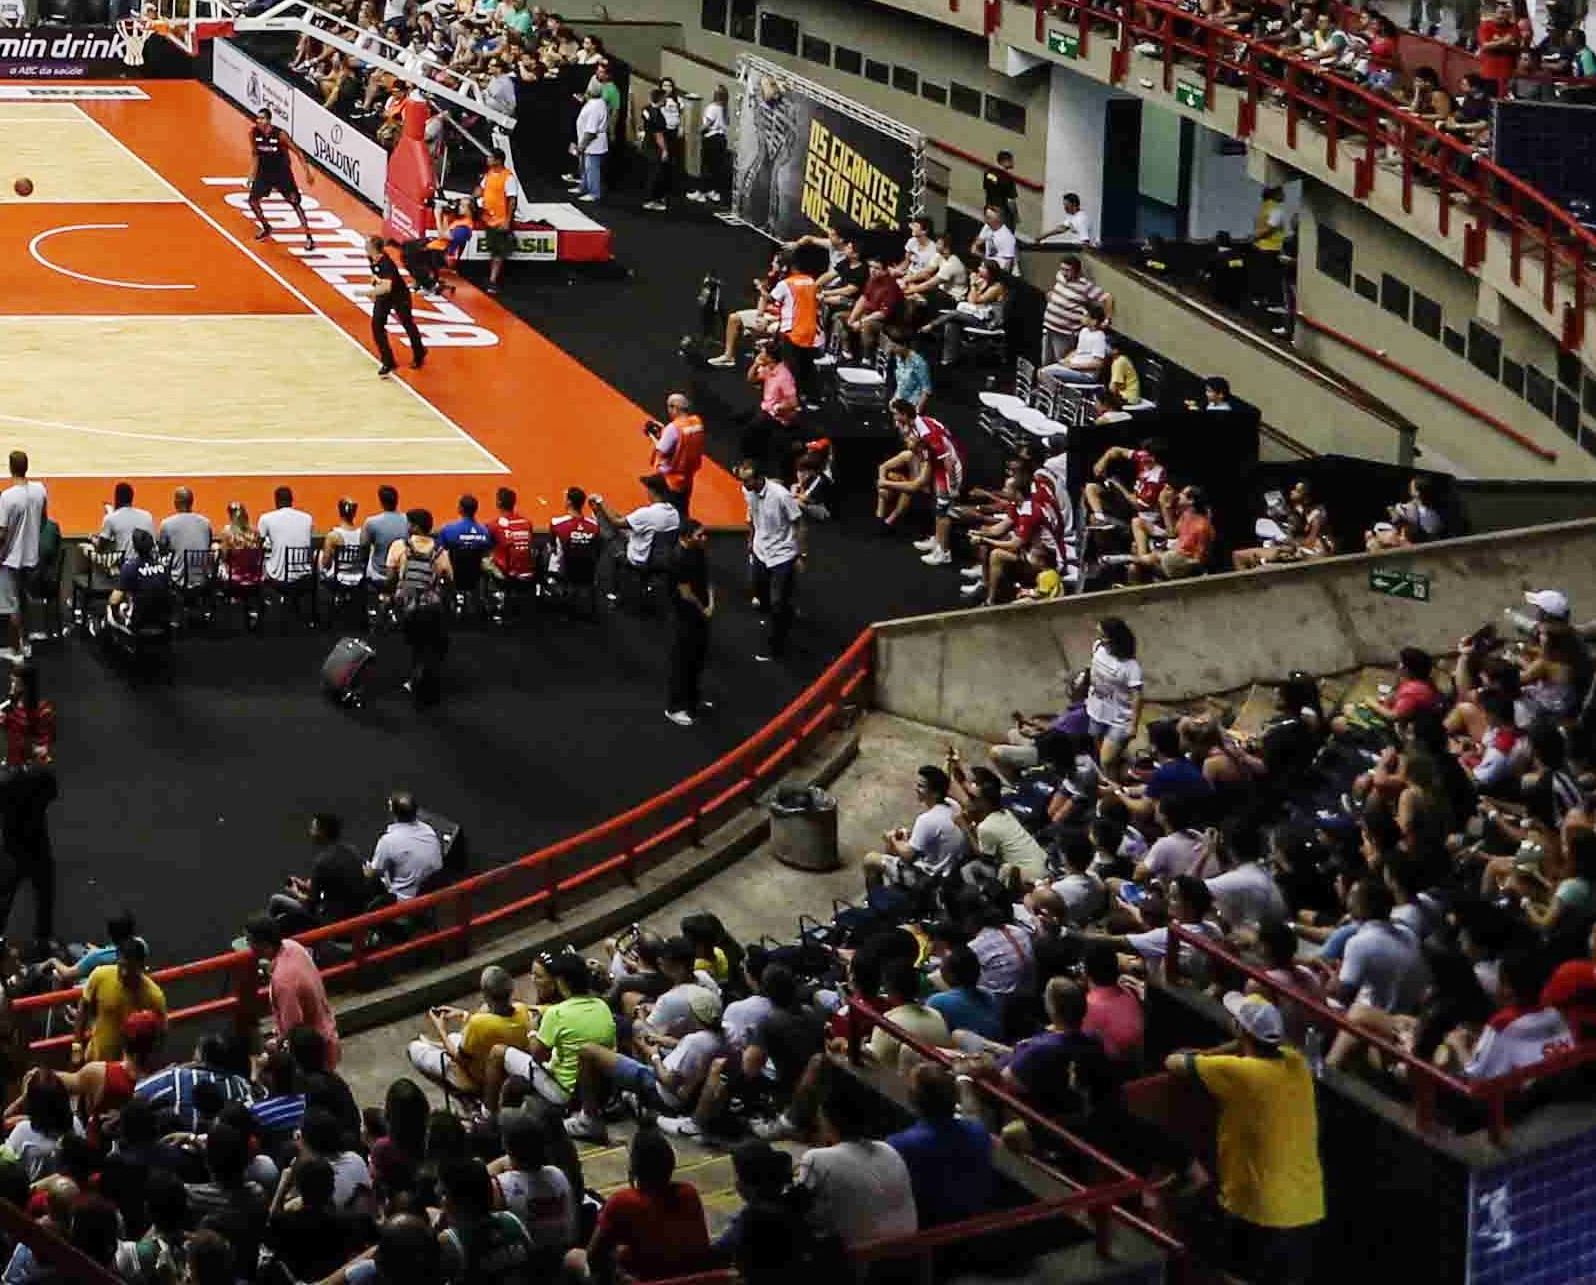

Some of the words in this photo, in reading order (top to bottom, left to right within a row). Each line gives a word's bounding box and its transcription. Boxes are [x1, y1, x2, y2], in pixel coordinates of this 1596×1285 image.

[50, 32, 128, 59] drink
[313, 132, 360, 186] SPALDING
[808, 118, 830, 159] OS
[830, 136, 900, 218] GIGANTES
[138, 562, 165, 576] vivo
